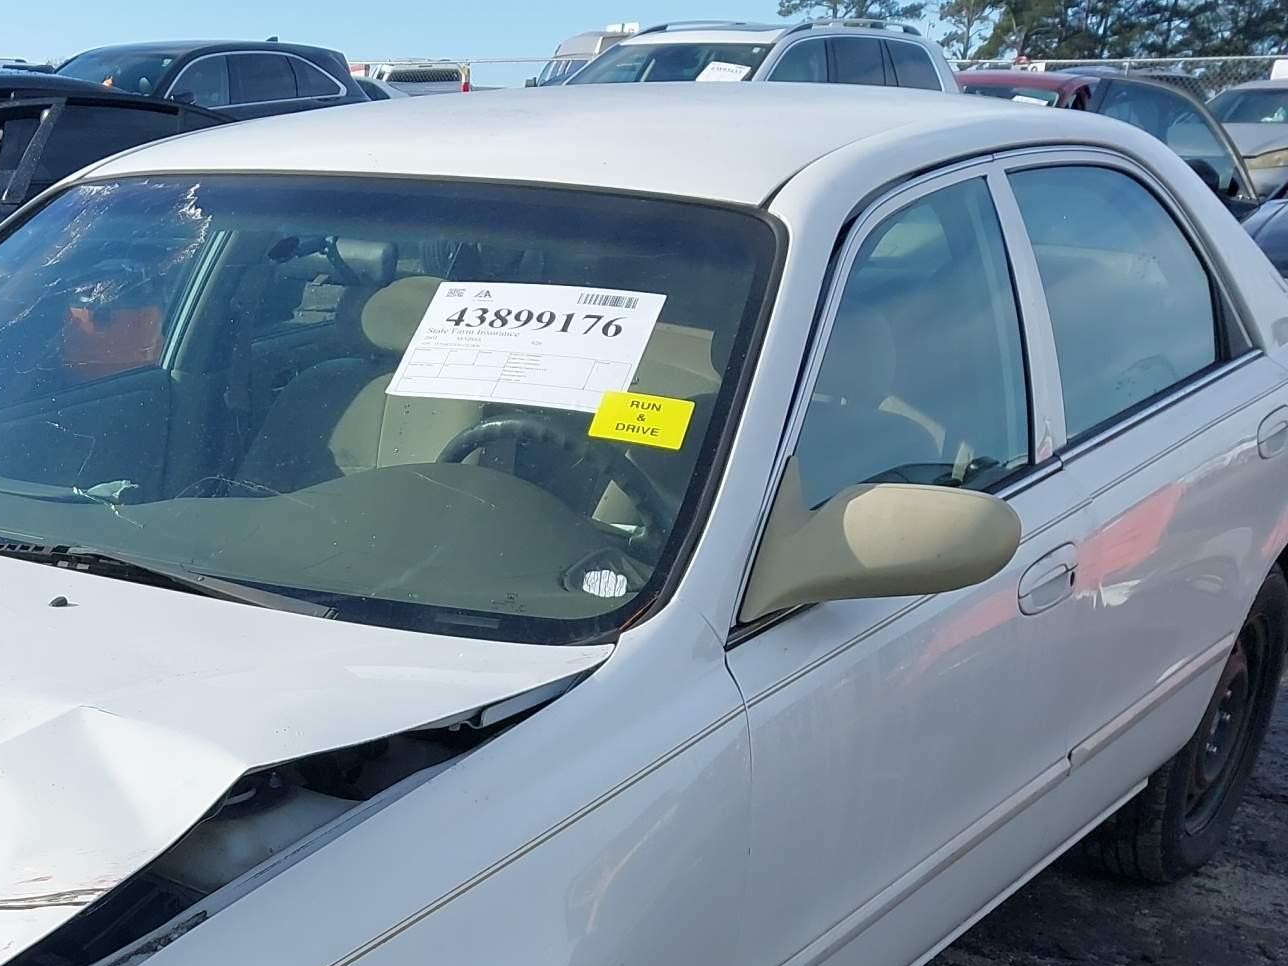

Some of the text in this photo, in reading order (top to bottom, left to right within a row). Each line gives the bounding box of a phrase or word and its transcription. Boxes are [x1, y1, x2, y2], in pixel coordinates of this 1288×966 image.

[445, 307, 628, 338] 43899176
[630, 400, 662, 411] RUN
[636, 413, 646, 422] &
[615, 422, 660, 437] DRIVE
